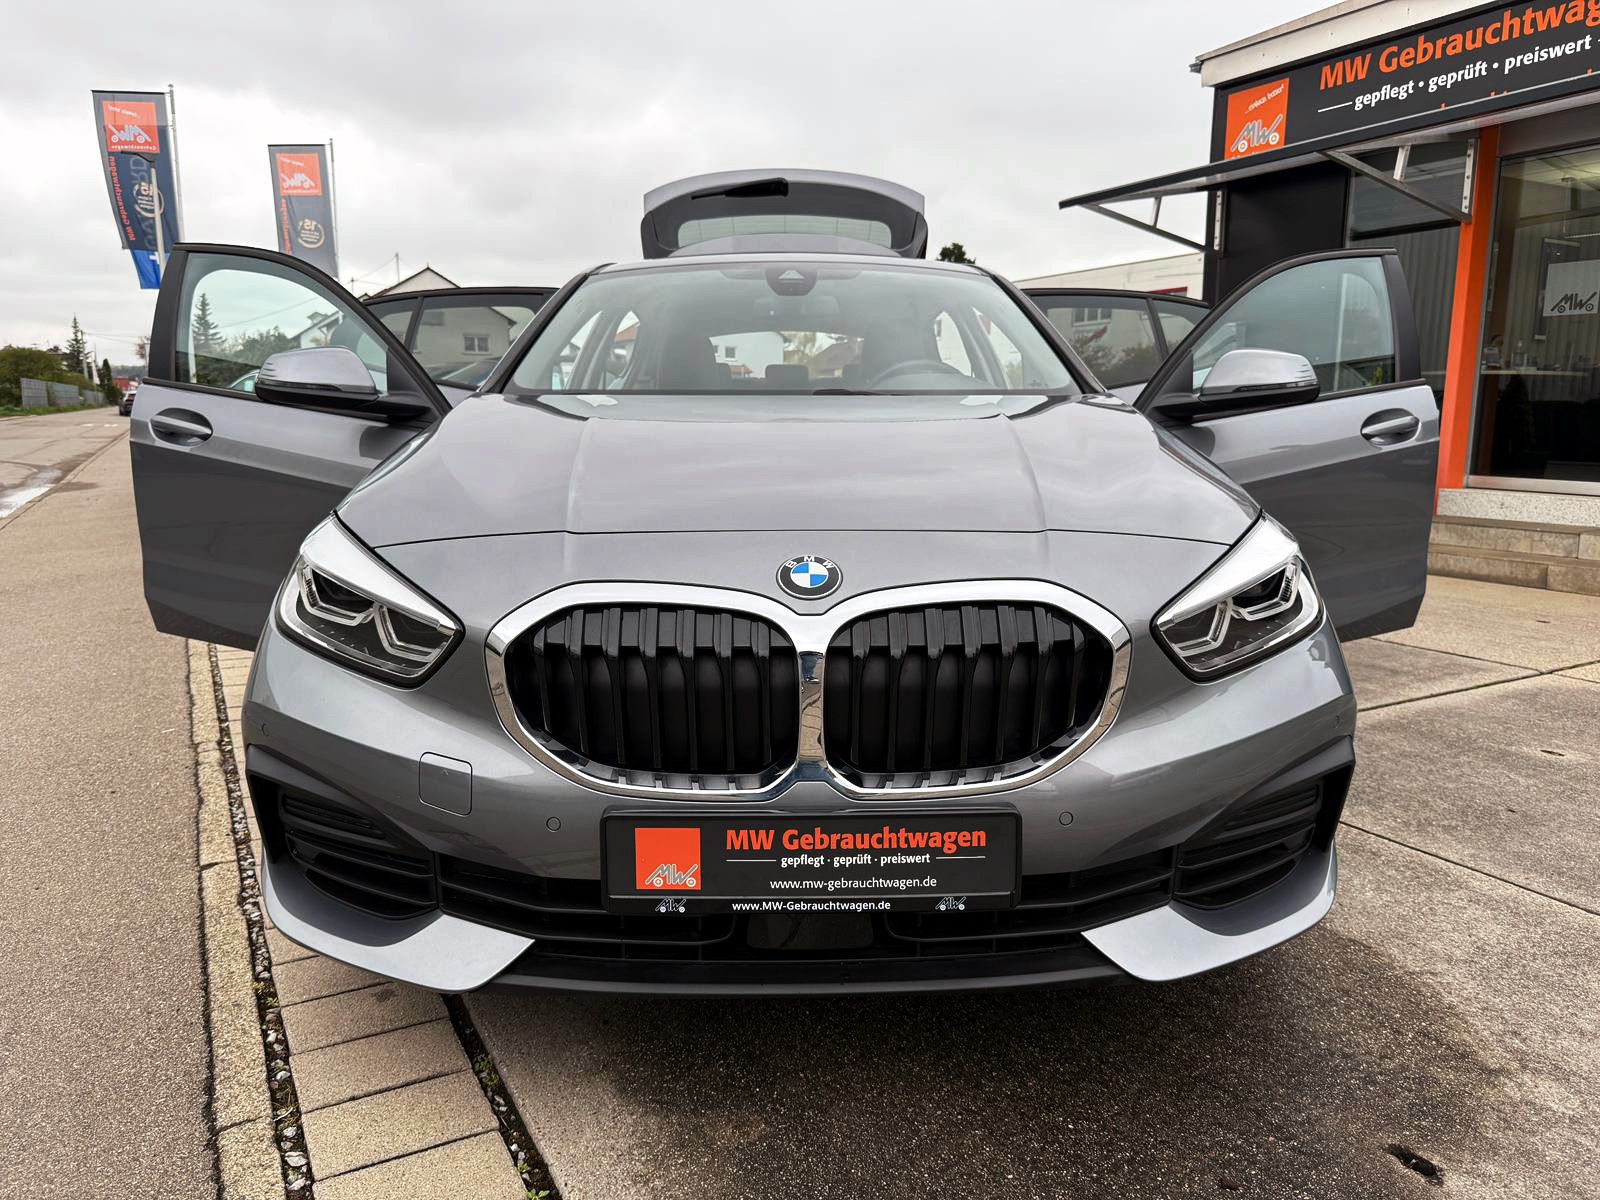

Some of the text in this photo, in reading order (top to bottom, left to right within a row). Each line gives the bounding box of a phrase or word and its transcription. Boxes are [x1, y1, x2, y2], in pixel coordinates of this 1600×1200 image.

[1319, 53, 1372, 90] MW
[1354, 34, 1592, 110] gepflegt geprüft preiswert
[784, 555, 835, 568] BMW
[726, 826, 986, 854] MW Gebrauchtwagen
[781, 853, 930, 868] gepflegt geprüft preiswert
[769, 876, 937, 891] www.mw-gebrauchtwagen.de
[731, 900, 891, 912] www.MW-Gebrauchtwagen.de
